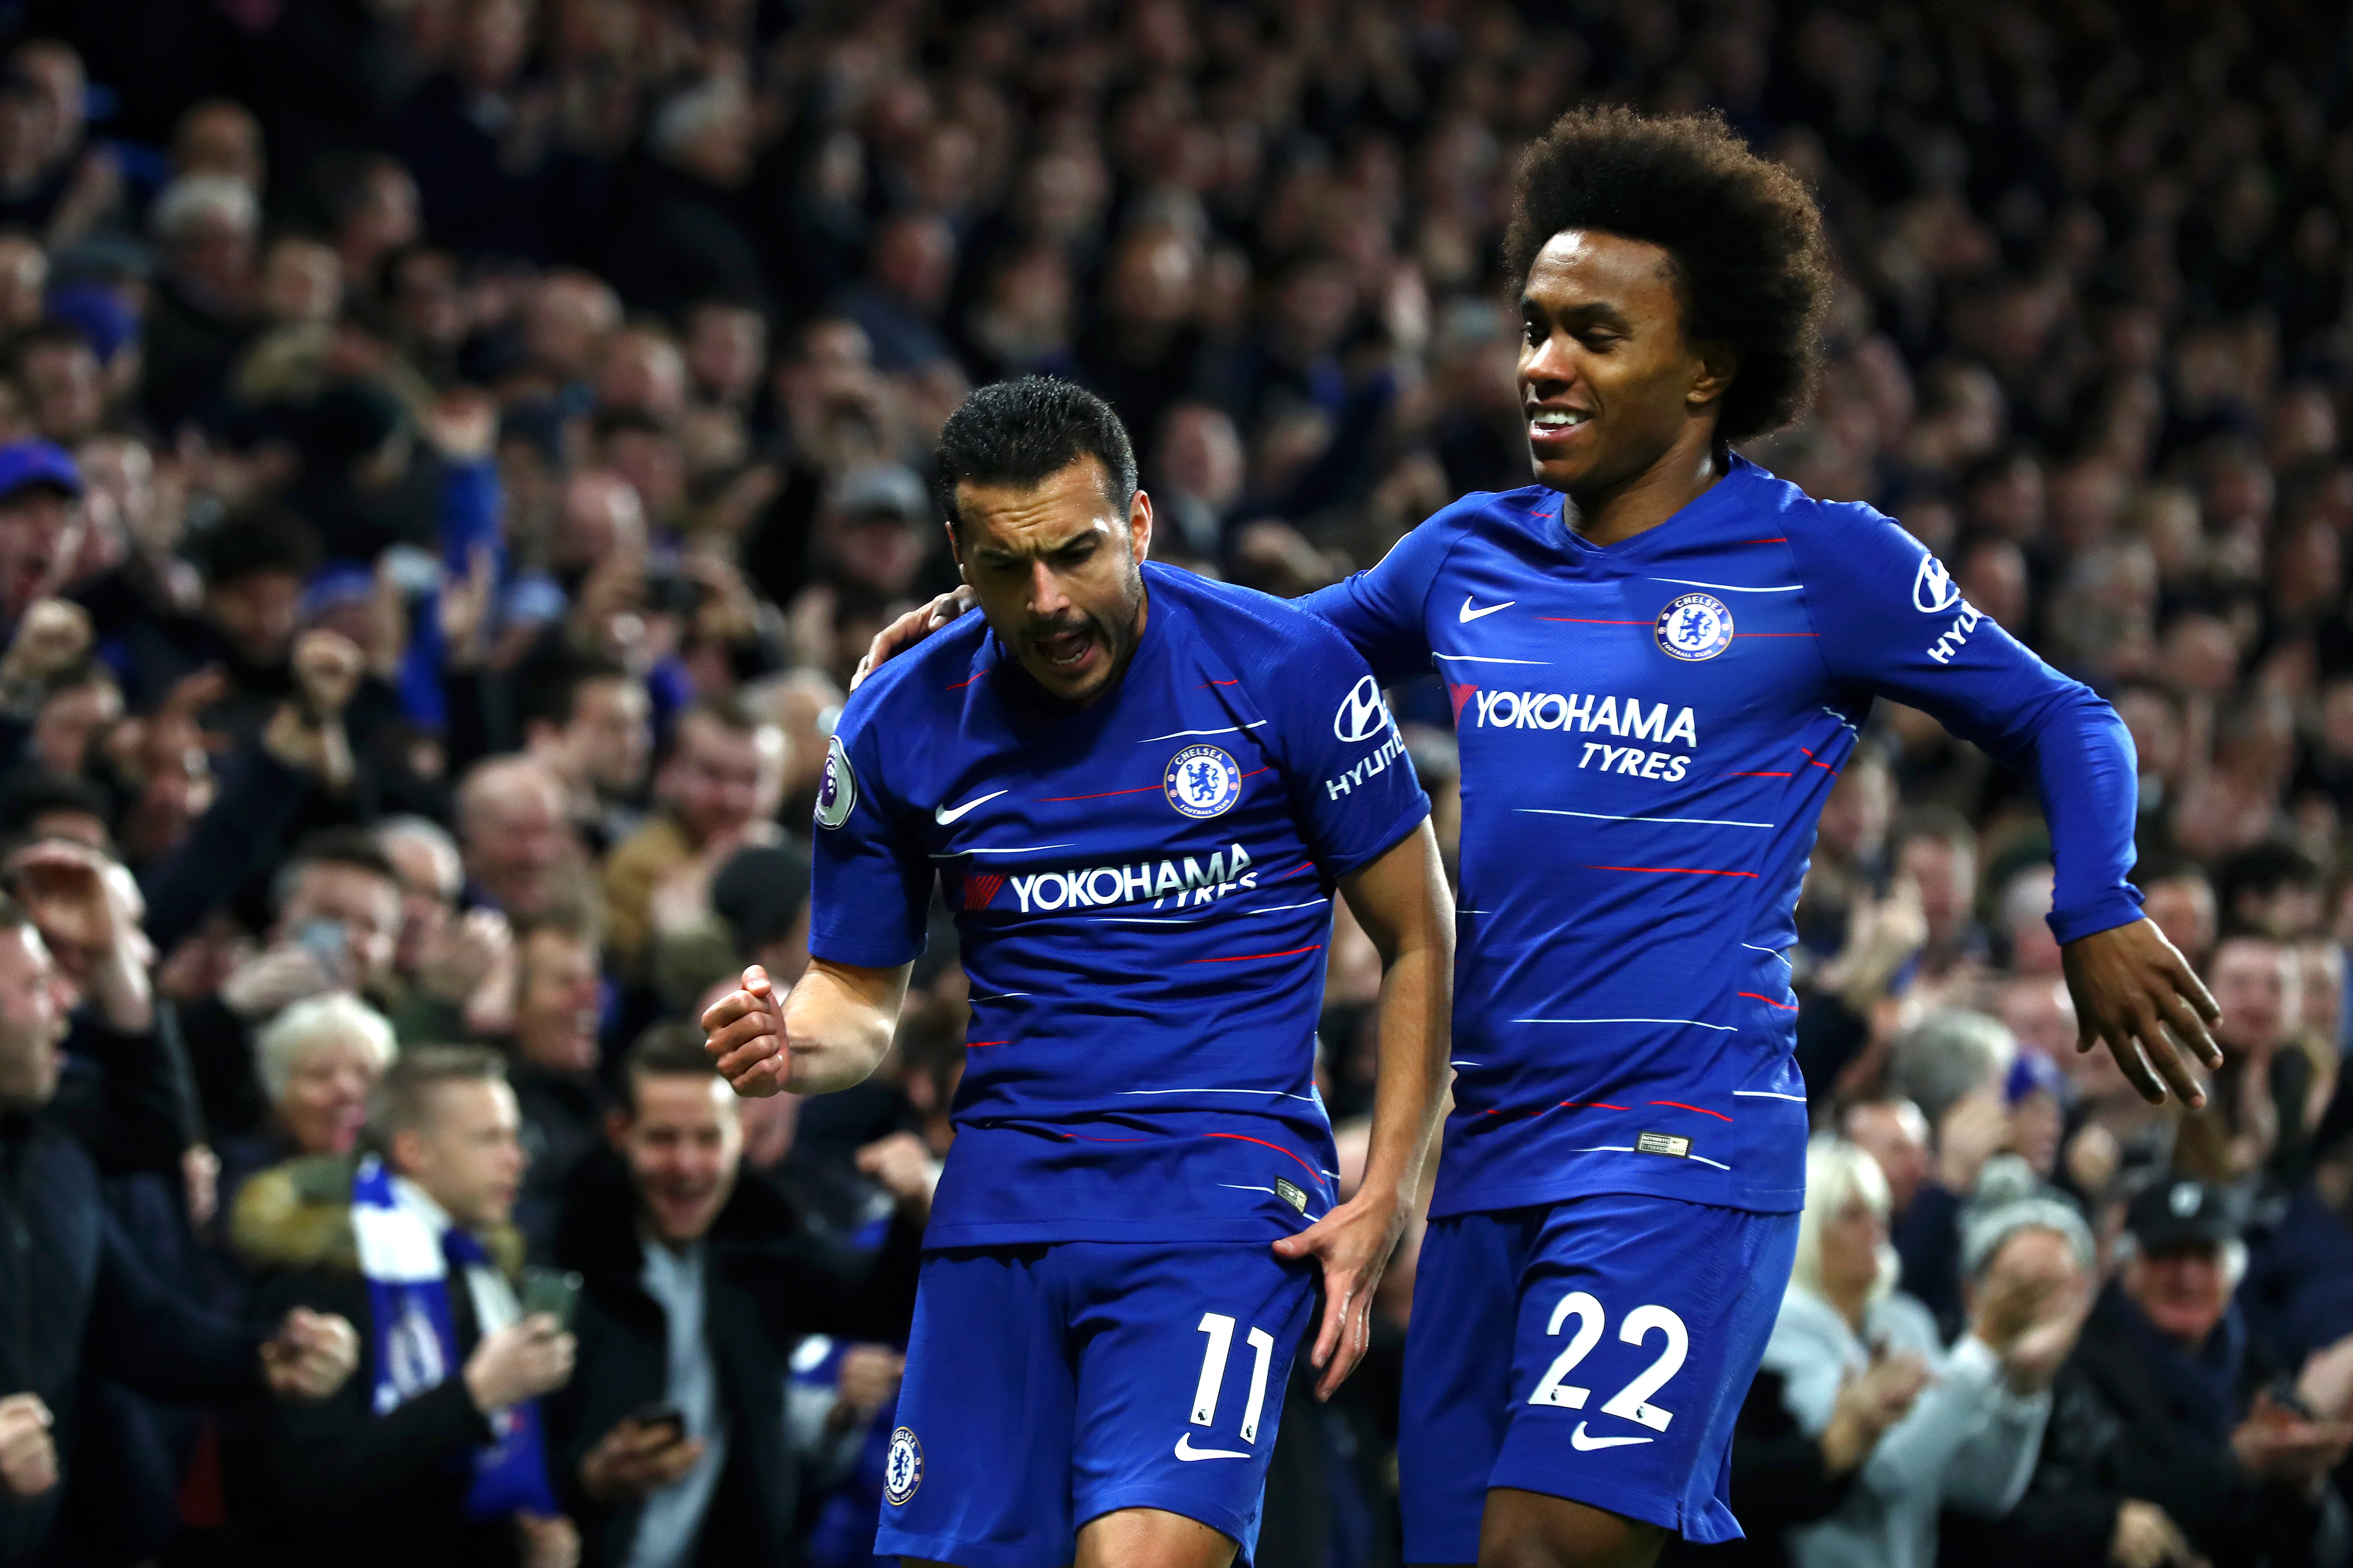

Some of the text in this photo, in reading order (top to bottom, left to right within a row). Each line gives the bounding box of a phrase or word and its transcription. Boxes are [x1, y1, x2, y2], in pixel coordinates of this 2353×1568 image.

[1675, 596, 1724, 615] CHELSEA
[1662, 642, 1712, 657] FOOTBALL CLUB
[1476, 690, 1697, 748] YOKOHAMA
[1175, 748, 1223, 765] CHELSEA
[1578, 742, 1692, 782] TYRES
[1179, 799, 1230, 814] FOOTBALL CLUB
[1010, 843, 1252, 913] YOKOHAMA
[1528, 1291, 1689, 1433] 22
[1190, 1312, 1274, 1445] 11
[891, 1431, 916, 1449] CHELSEA
